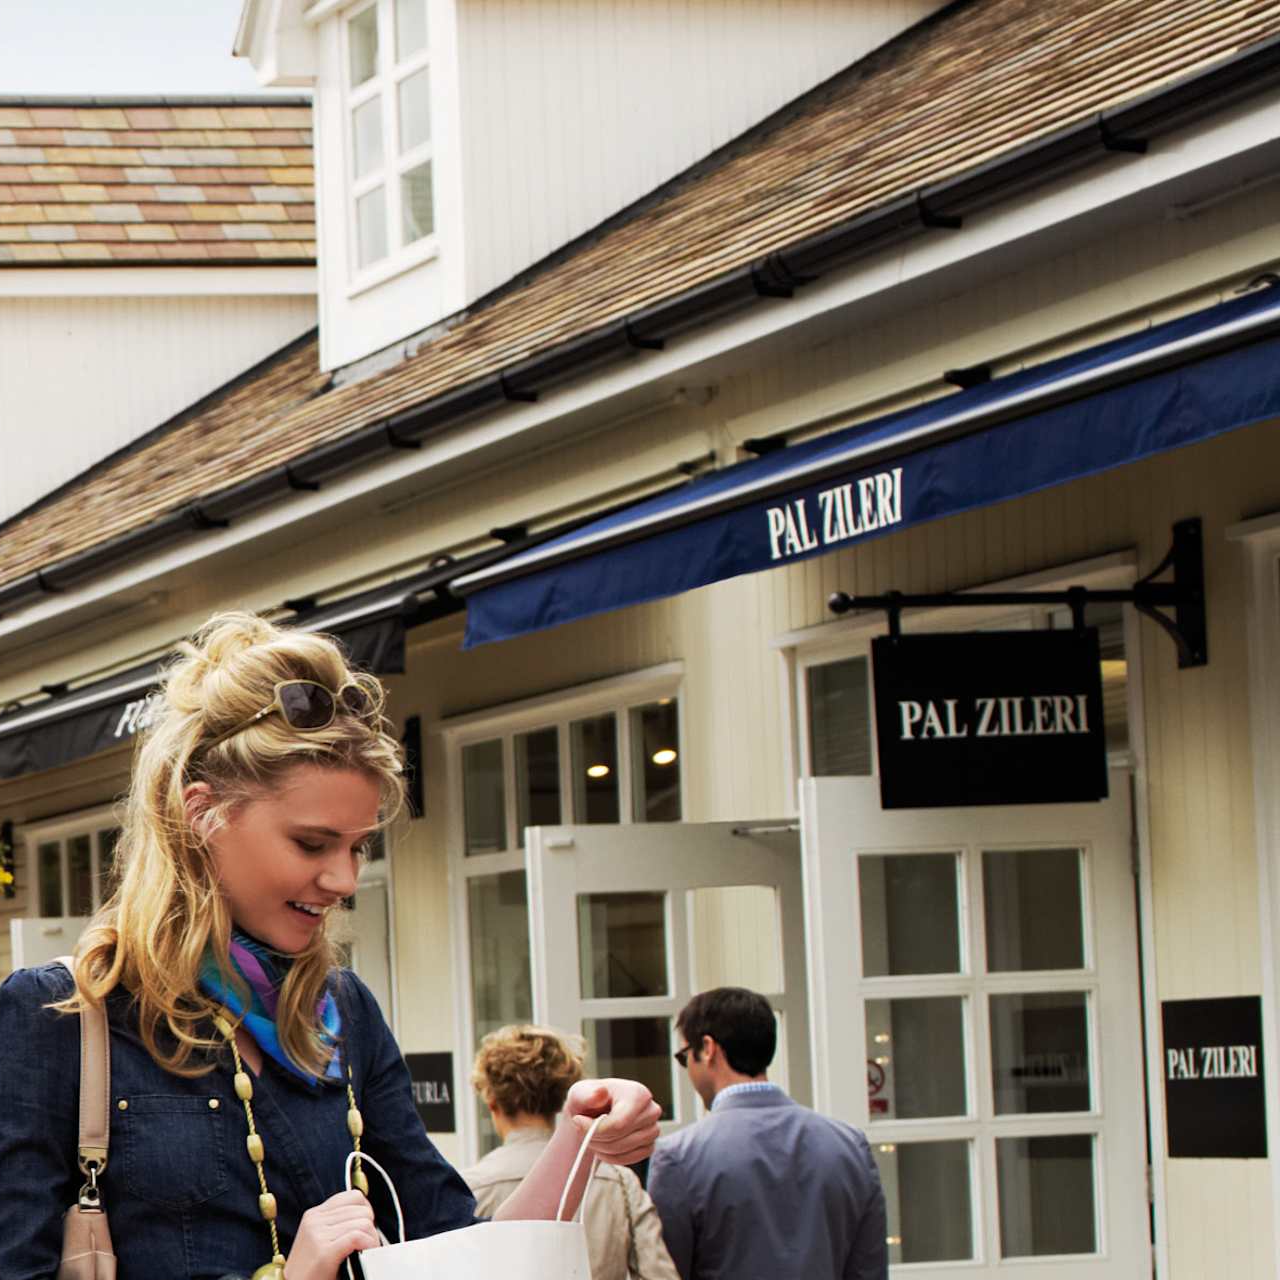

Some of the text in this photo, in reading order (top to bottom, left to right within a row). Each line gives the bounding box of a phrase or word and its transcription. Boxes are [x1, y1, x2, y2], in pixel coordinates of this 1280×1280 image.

[766, 467, 904, 560] PAL ZILERI
[897, 694, 1090, 740] PAL ZILERI
[1167, 1044, 1258, 1080] PAL ZILERI
